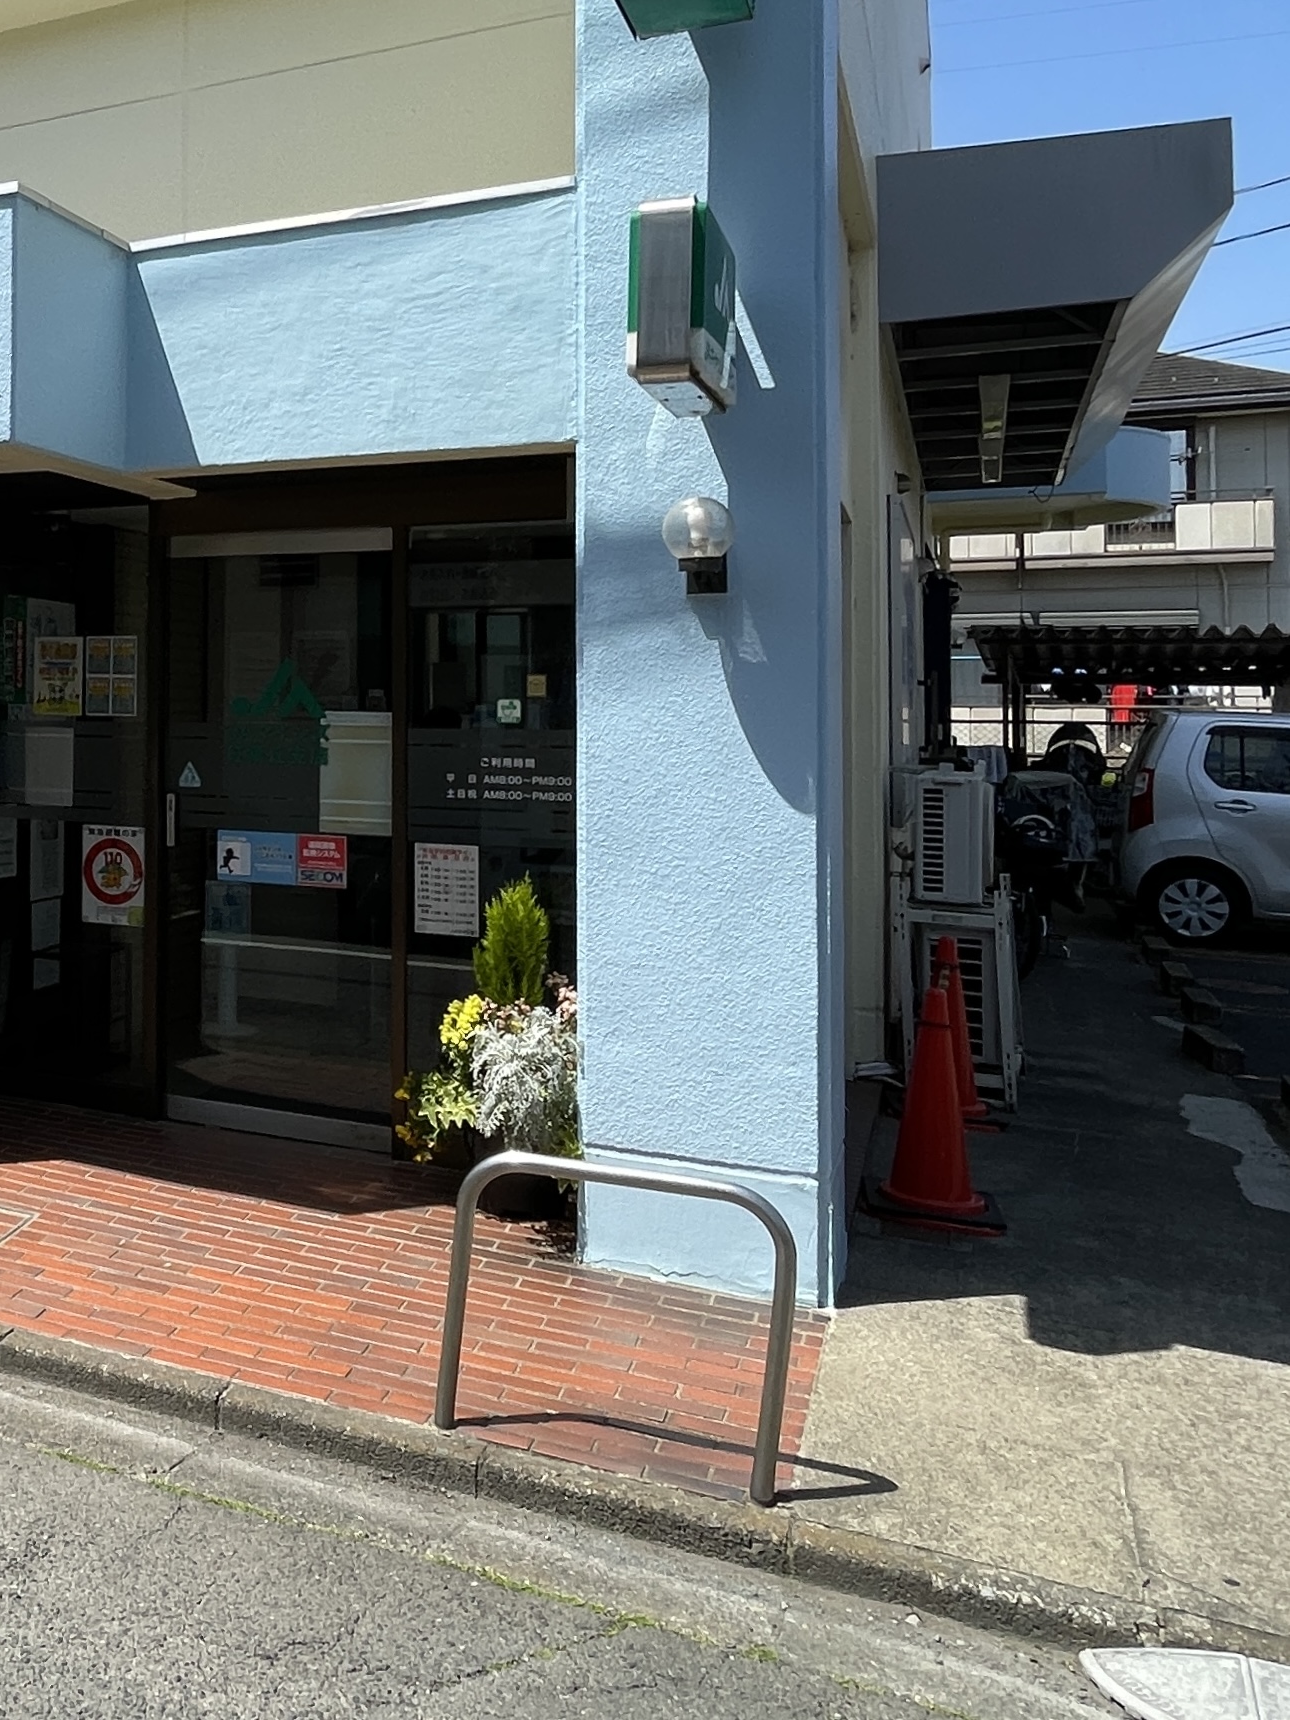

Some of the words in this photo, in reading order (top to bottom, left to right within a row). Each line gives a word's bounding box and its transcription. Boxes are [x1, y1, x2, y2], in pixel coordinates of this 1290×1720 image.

[480, 757, 536, 769] ご利用時間
[300, 870, 343, 883] SECOM
